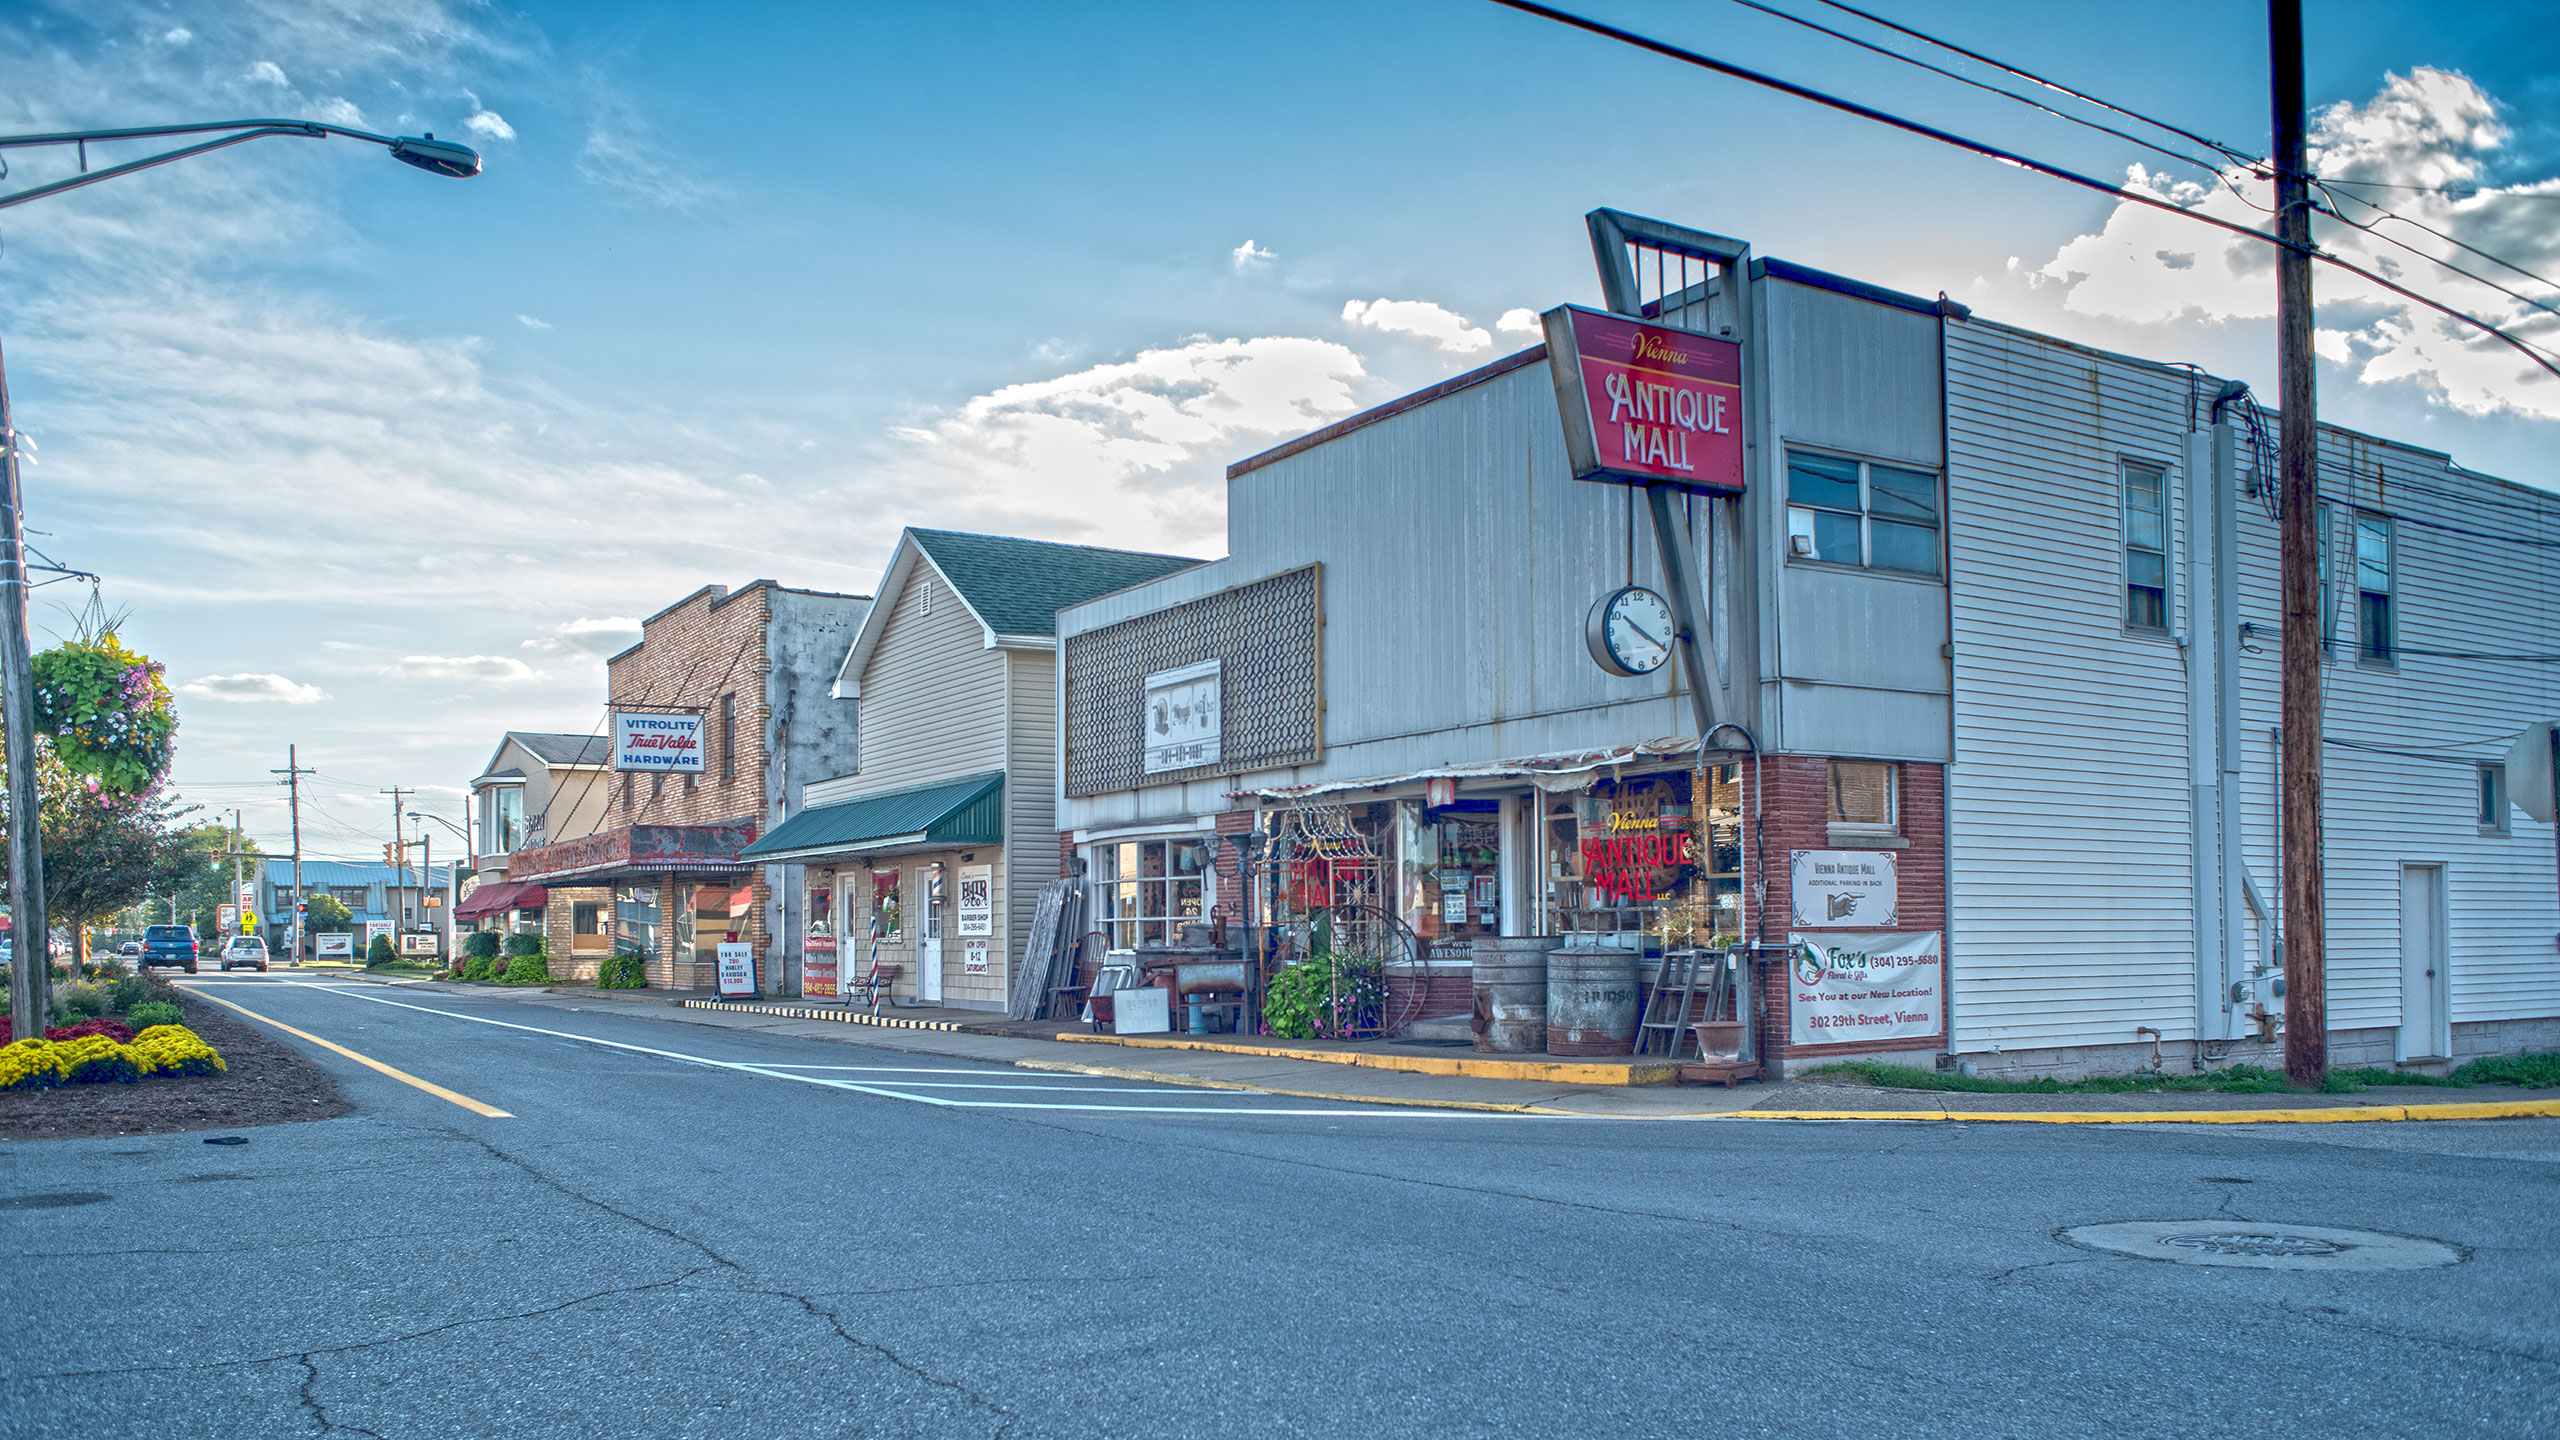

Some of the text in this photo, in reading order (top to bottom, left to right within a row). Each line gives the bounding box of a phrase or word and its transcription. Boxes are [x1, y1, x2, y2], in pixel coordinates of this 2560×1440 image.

[1630, 332, 1689, 365] Vienna
[1605, 373, 1729, 434] ANTIQUE
[1623, 422, 1694, 472] MALL
[1620, 597, 1629, 606] 11
[1632, 592, 1644, 601] 12
[1650, 597, 1655, 606] 1
[1610, 611, 1621, 620] 10
[1659, 610, 1666, 619] 2
[1664, 626, 1671, 636] 3
[1613, 643, 1620, 653] 8
[1623, 657, 1630, 665] 7
[1638, 661, 1645, 670] 6
[1651, 656, 1658, 665] 5
[626, 719, 696, 730] VITROLITE
[624, 754, 699, 765] HARDWARE
[1606, 811, 1659, 833] Vienna
[1581, 833, 1693, 876] ANTIQUE
[1441, 877, 1458, 886] CLOSED
[1596, 869, 1657, 901] MALL
[977, 913, 989, 921] SHOP
[970, 951, 981, 961] 8-12
[1827, 947, 1866, 970] Fox's
[1870, 954, 1938, 969] (304) 295-5680
[966, 963, 986, 973] SATURDAYS
[1827, 972, 1847, 981] Floral
[1853, 971, 1868, 981] Gifts
[1798, 993, 1817, 1002] See
[1818, 992, 1837, 1001] You
[1838, 993, 1848, 1001] at
[1870, 990, 1890, 999] New
[1891, 988, 1933, 998] Location!
[1809, 1010, 1929, 1029] 302 29th Street, Vienna
